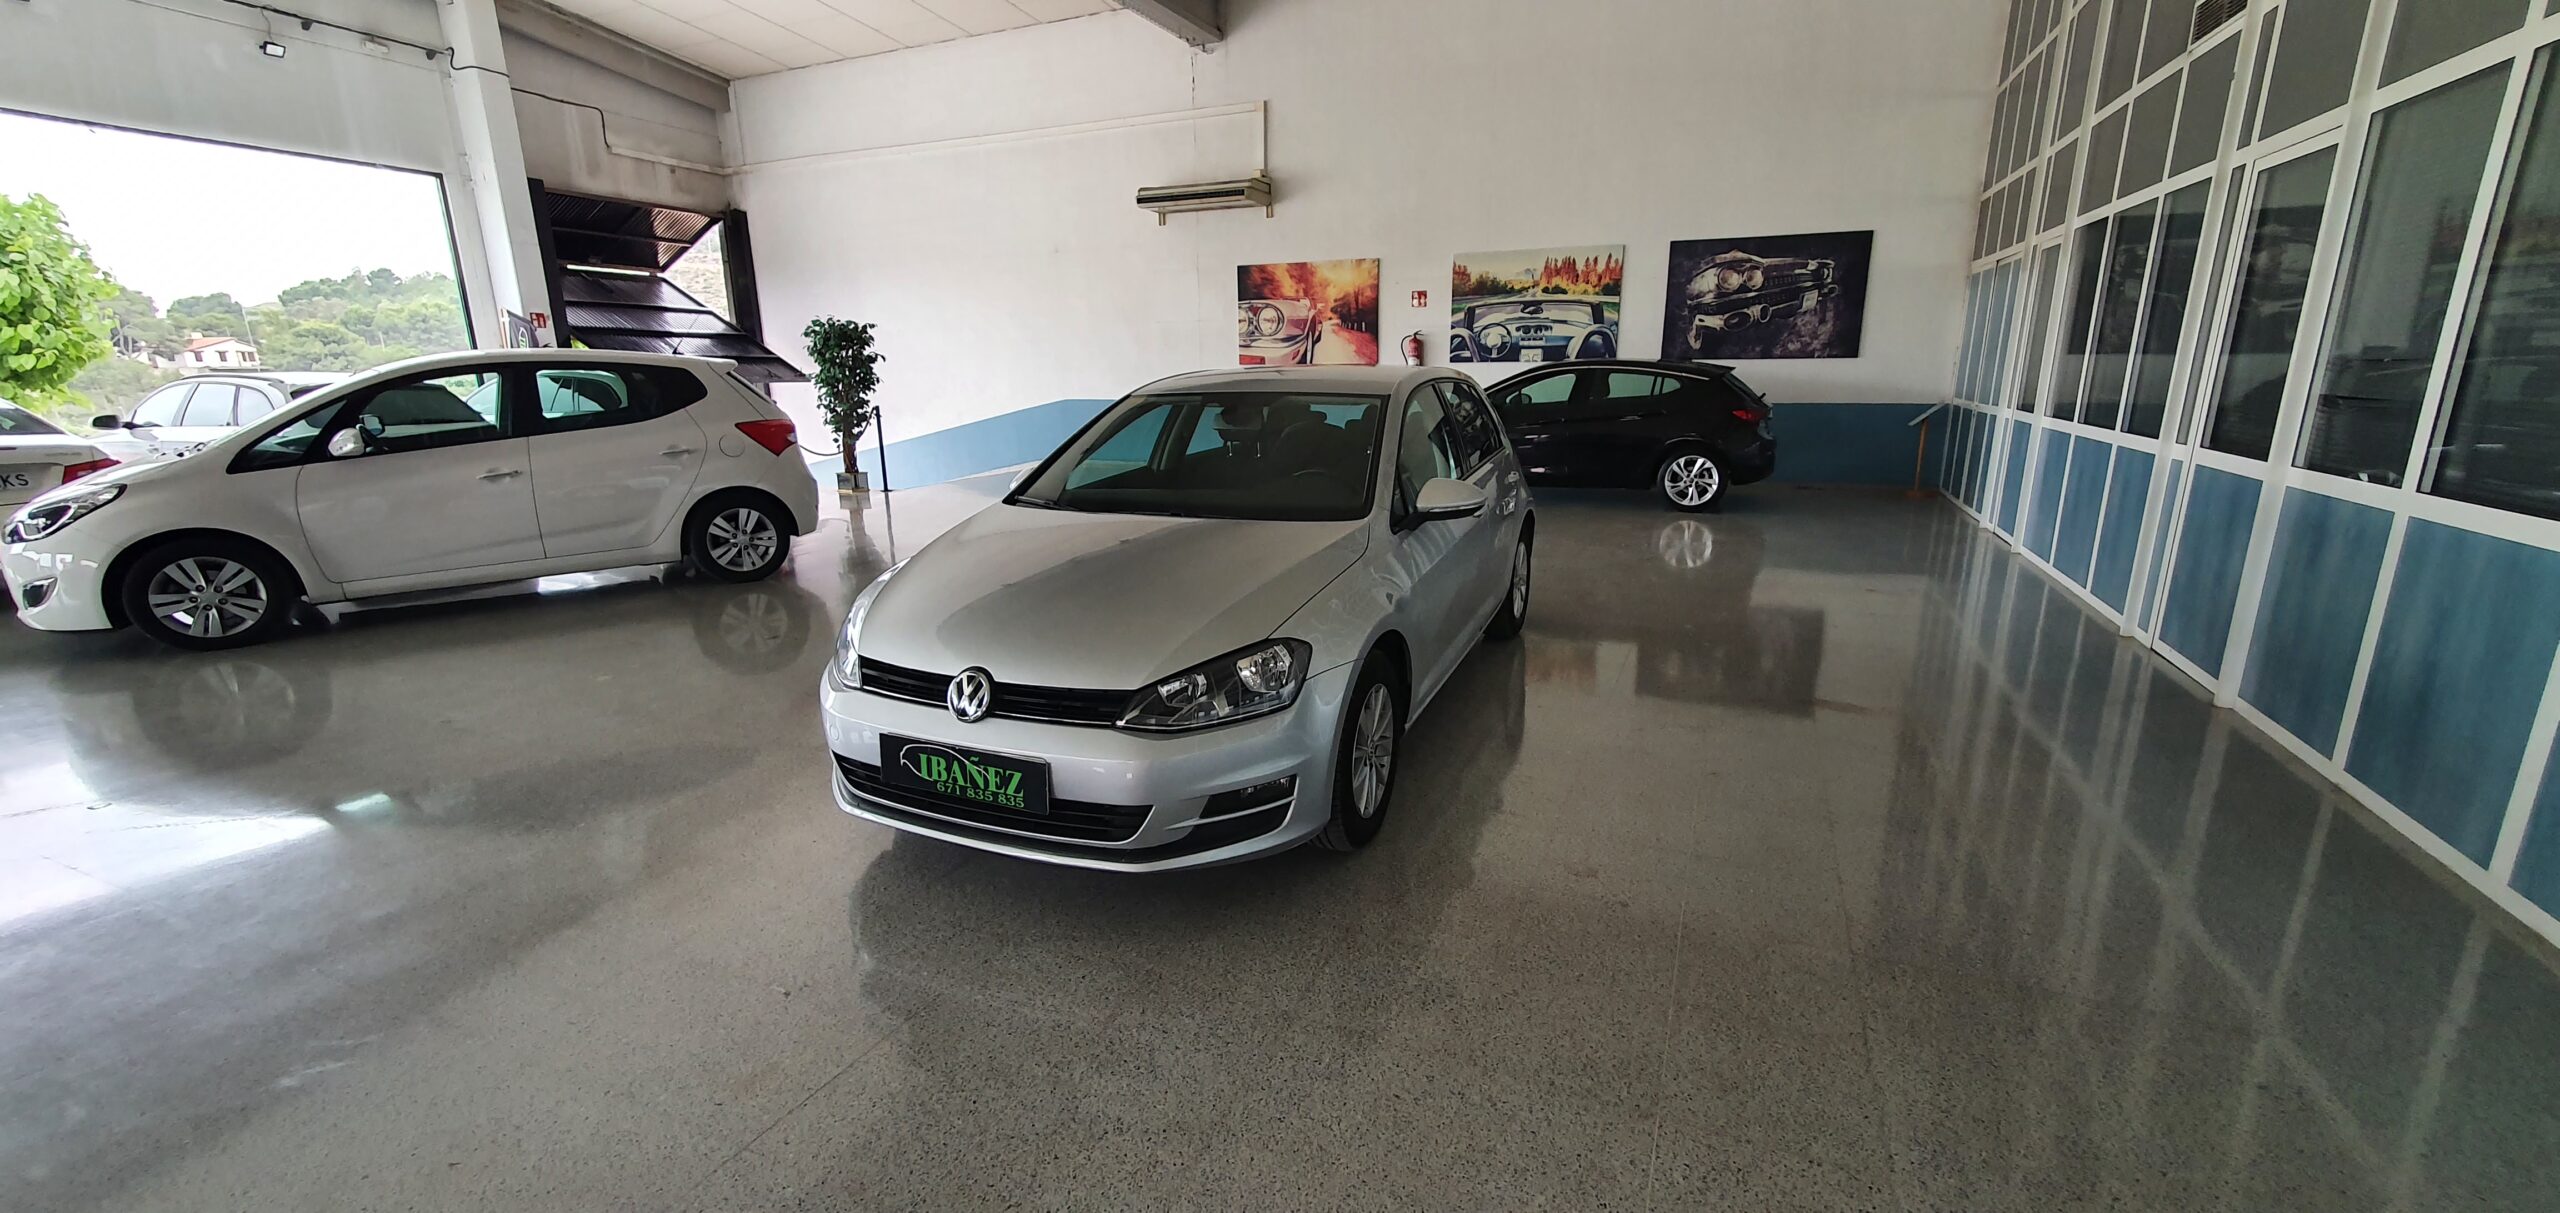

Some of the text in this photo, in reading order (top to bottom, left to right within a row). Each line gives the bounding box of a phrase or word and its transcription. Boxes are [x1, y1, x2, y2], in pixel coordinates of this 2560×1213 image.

[0, 473, 29, 488] KS
[918, 753, 1024, 797] IBAÑEZ
[937, 782, 1025, 808] 671 835 835
